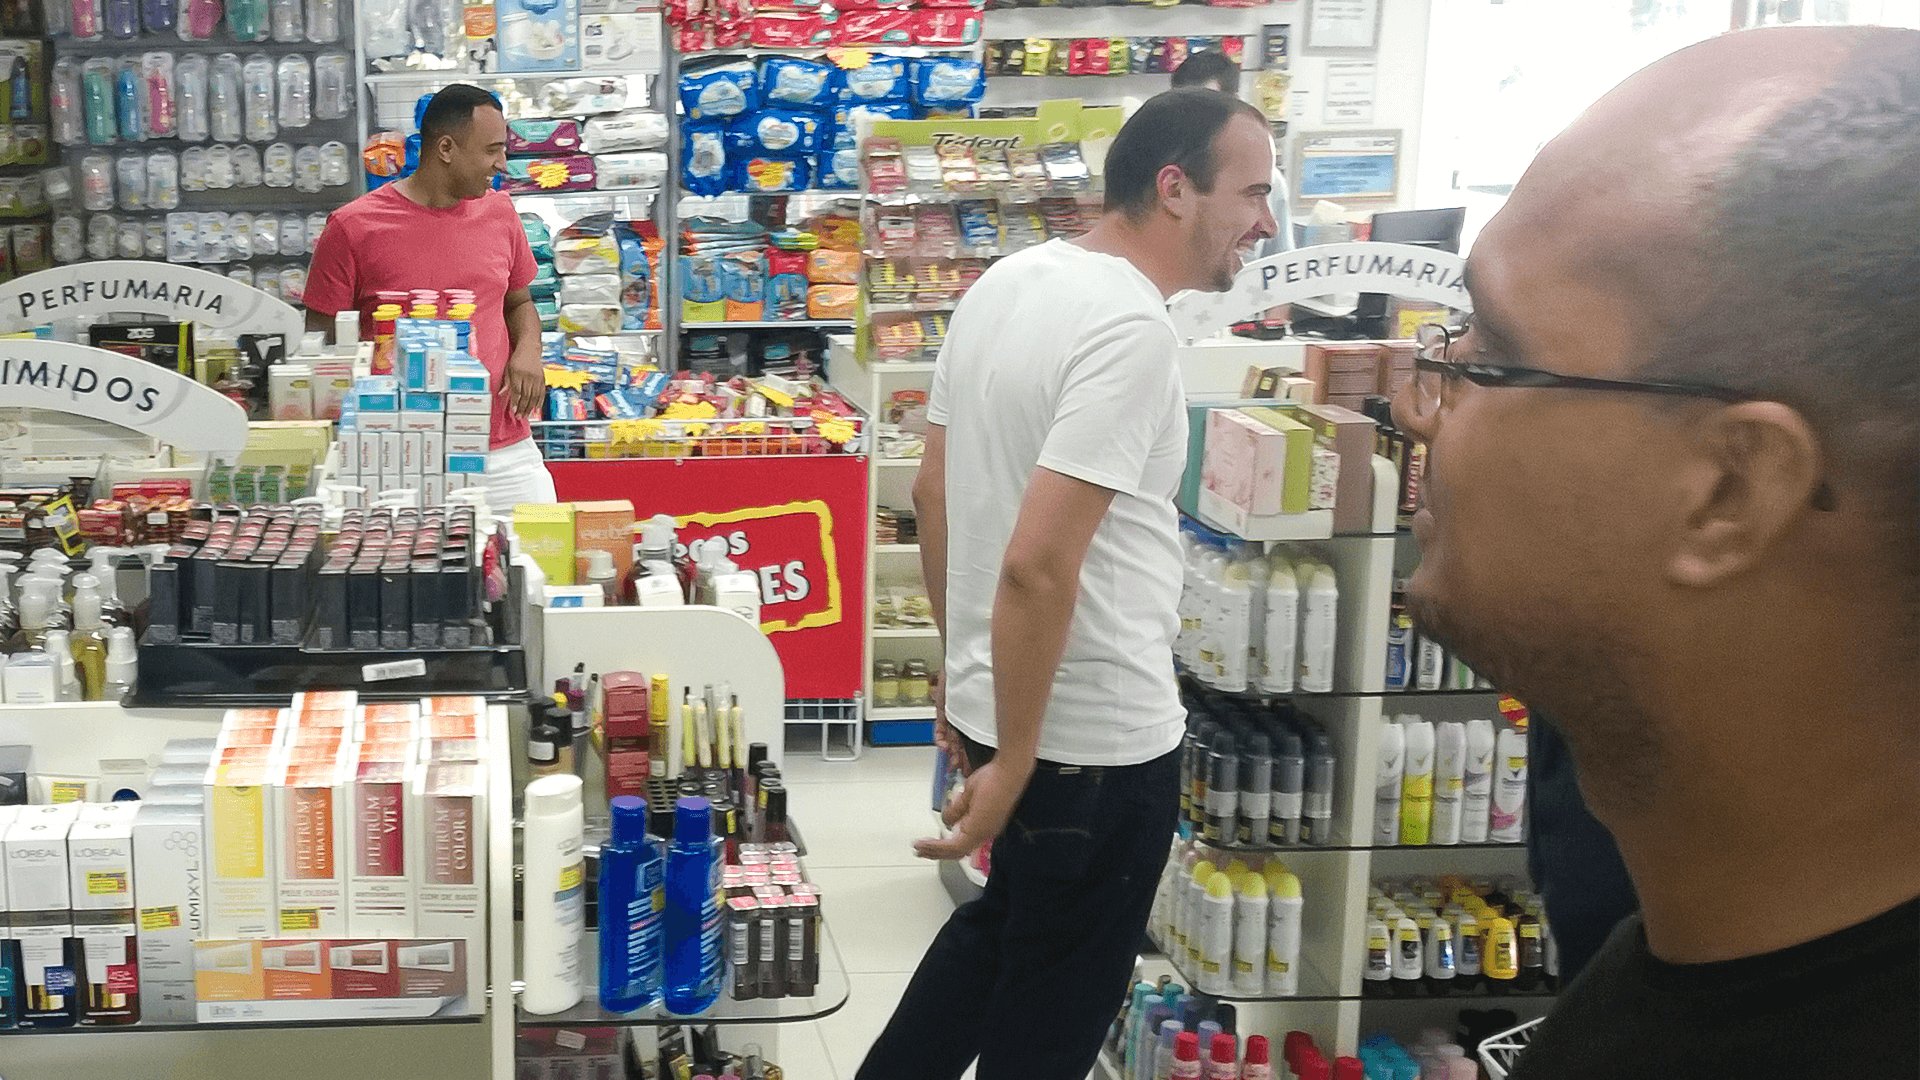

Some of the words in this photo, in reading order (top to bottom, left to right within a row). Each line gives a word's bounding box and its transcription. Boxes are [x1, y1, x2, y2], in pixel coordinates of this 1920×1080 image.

[1262, 255, 1464, 293] PERFUMARIA
[19, 279, 223, 318] PERFUMARIA
[452, 820, 466, 871] COLOR
